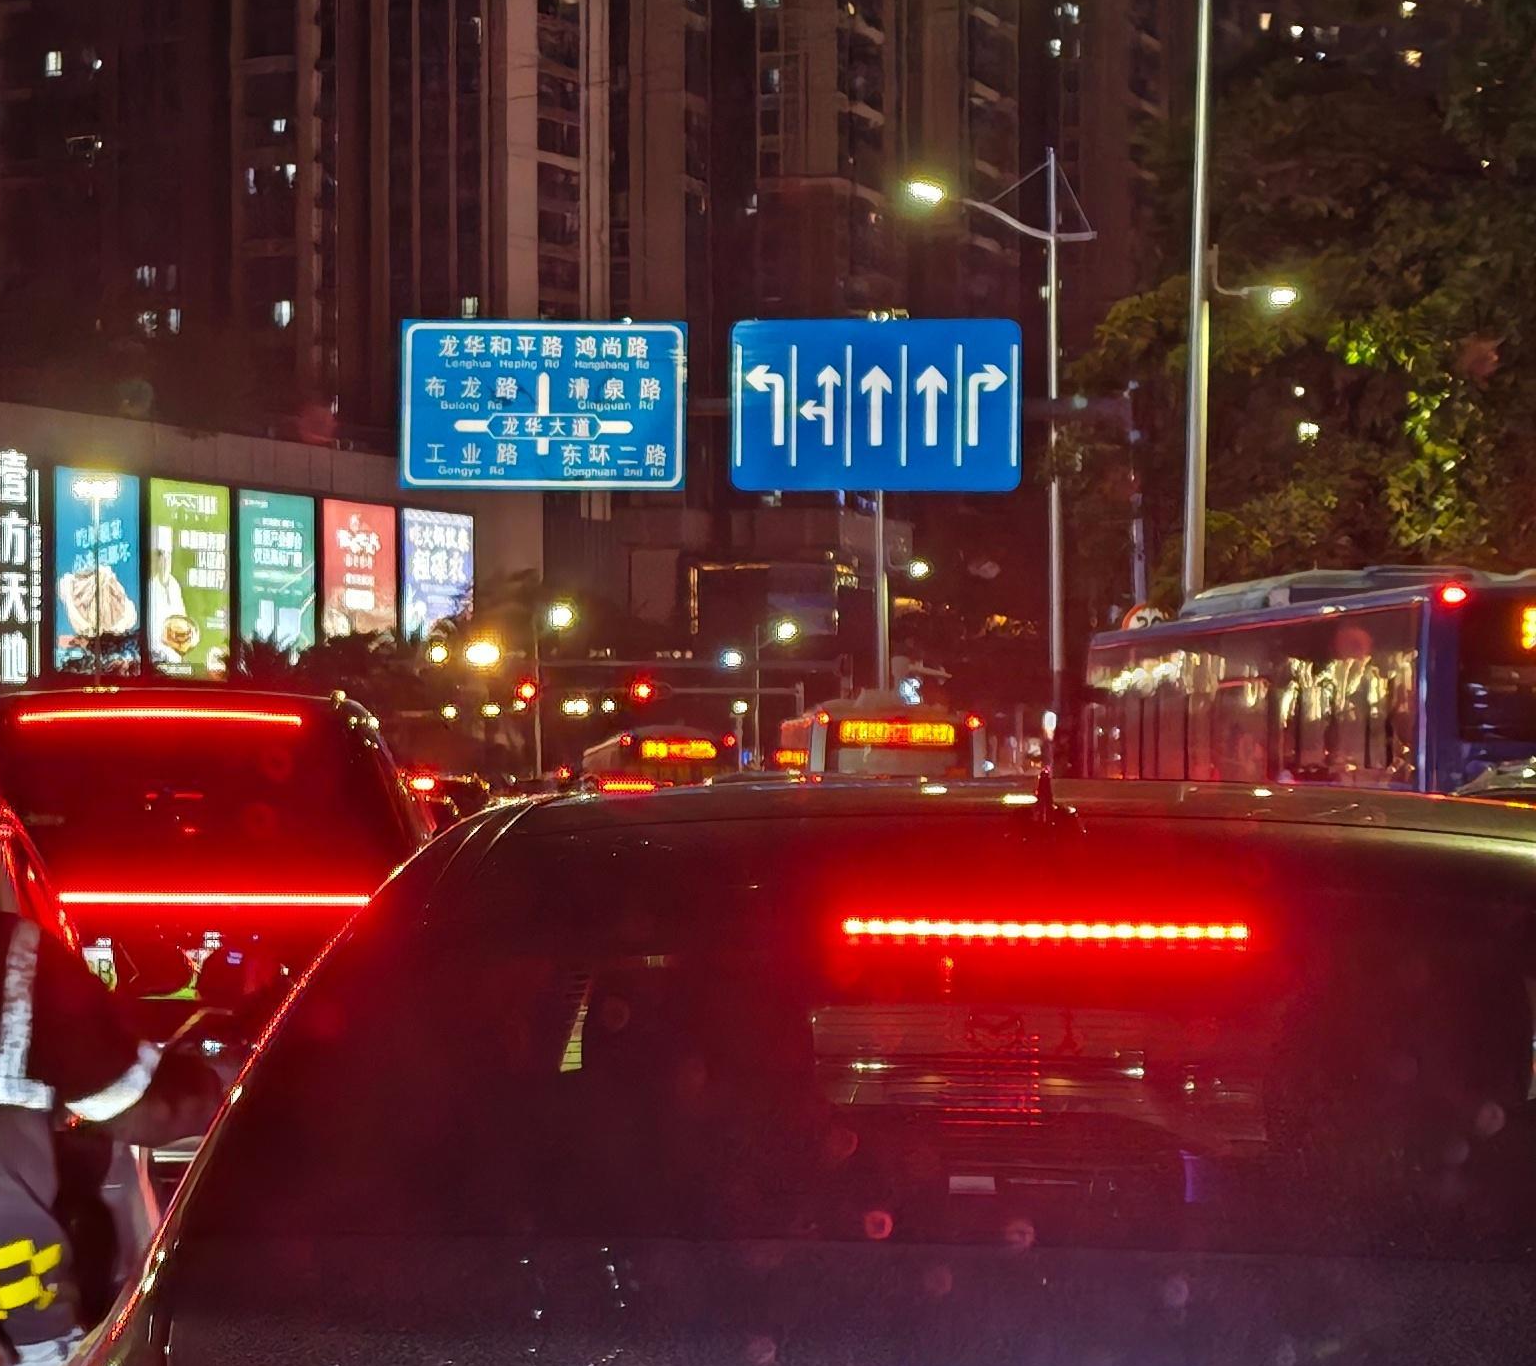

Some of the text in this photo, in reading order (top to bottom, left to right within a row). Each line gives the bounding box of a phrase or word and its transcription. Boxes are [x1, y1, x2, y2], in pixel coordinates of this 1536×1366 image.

[438, 335, 648, 359] 龙华和平路 鸿尚路
[445, 359, 492, 370] Longhua
[499, 360, 538, 370] Heping
[544, 359, 560, 369] Rd
[636, 360, 650, 370] Rd
[425, 376, 518, 400] 布龙路
[568, 377, 661, 401] 清泉路
[440, 400, 503, 412] Bulong Rd
[639, 401, 654, 410] Rd
[502, 417, 590, 437] 龙华大道
[425, 443, 518, 465] 工业路
[561, 444, 667, 466] 东环二路
[438, 466, 504, 477] Gongye Rd
[650, 467, 665, 476] Rd
